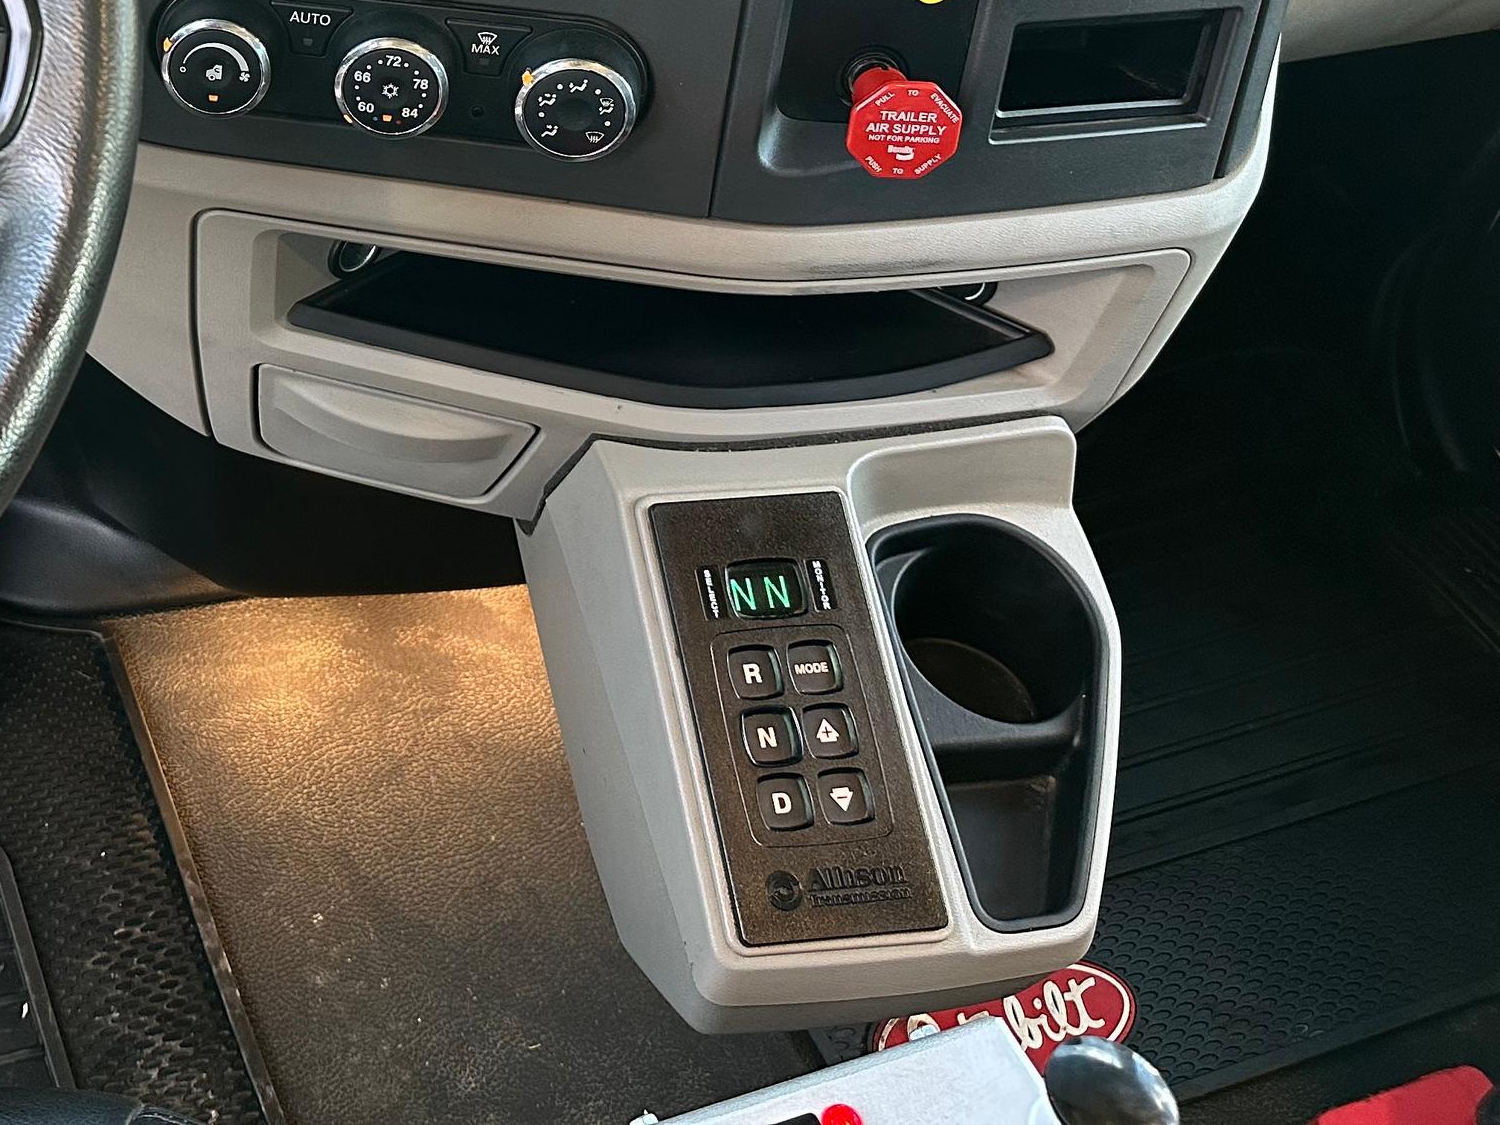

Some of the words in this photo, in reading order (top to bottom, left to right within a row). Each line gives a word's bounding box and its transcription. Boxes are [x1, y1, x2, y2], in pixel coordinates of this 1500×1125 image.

[290, 10, 331, 26] AUTO
[471, 44, 500, 56] MAX
[385, 55, 403, 68] 72
[354, 70, 371, 83] 66
[412, 78, 429, 91] 78
[875, 92, 895, 106] PULL
[357, 101, 375, 114] 60
[401, 107, 419, 119] 84
[930, 93, 960, 124] EVACUATE
[880, 111, 937, 123] TRAILER
[865, 123, 889, 133] AIR
[892, 124, 947, 136] SUPPLY
[904, 136, 940, 144] PARKING
[865, 156, 882, 173] PUSH
[914, 153, 942, 175] SUPPLY
[812, 560, 831, 610] MONITOR
[703, 568, 720, 619] SELECT
[730, 577, 757, 612] N
[764, 575, 790, 609] N
[743, 662, 763, 685] R
[794, 660, 829, 675] MODE
[757, 727, 778, 749] N
[771, 792, 792, 815] D
